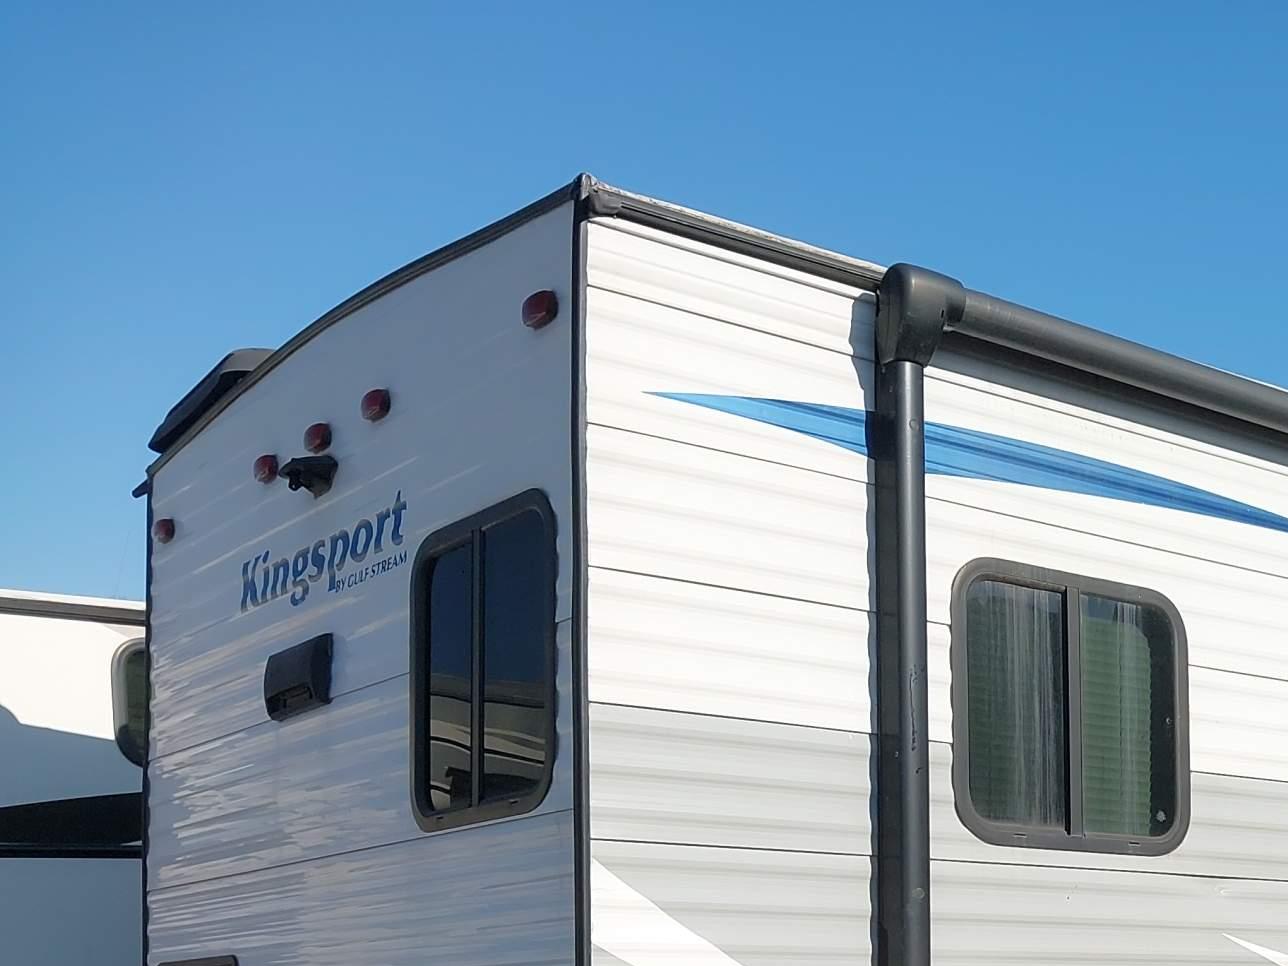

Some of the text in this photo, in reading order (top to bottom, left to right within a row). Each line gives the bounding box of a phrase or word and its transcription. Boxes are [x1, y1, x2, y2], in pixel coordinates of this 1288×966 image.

[240, 489, 408, 613] Kingsport
[335, 549, 408, 593] BY GULF STREAM
